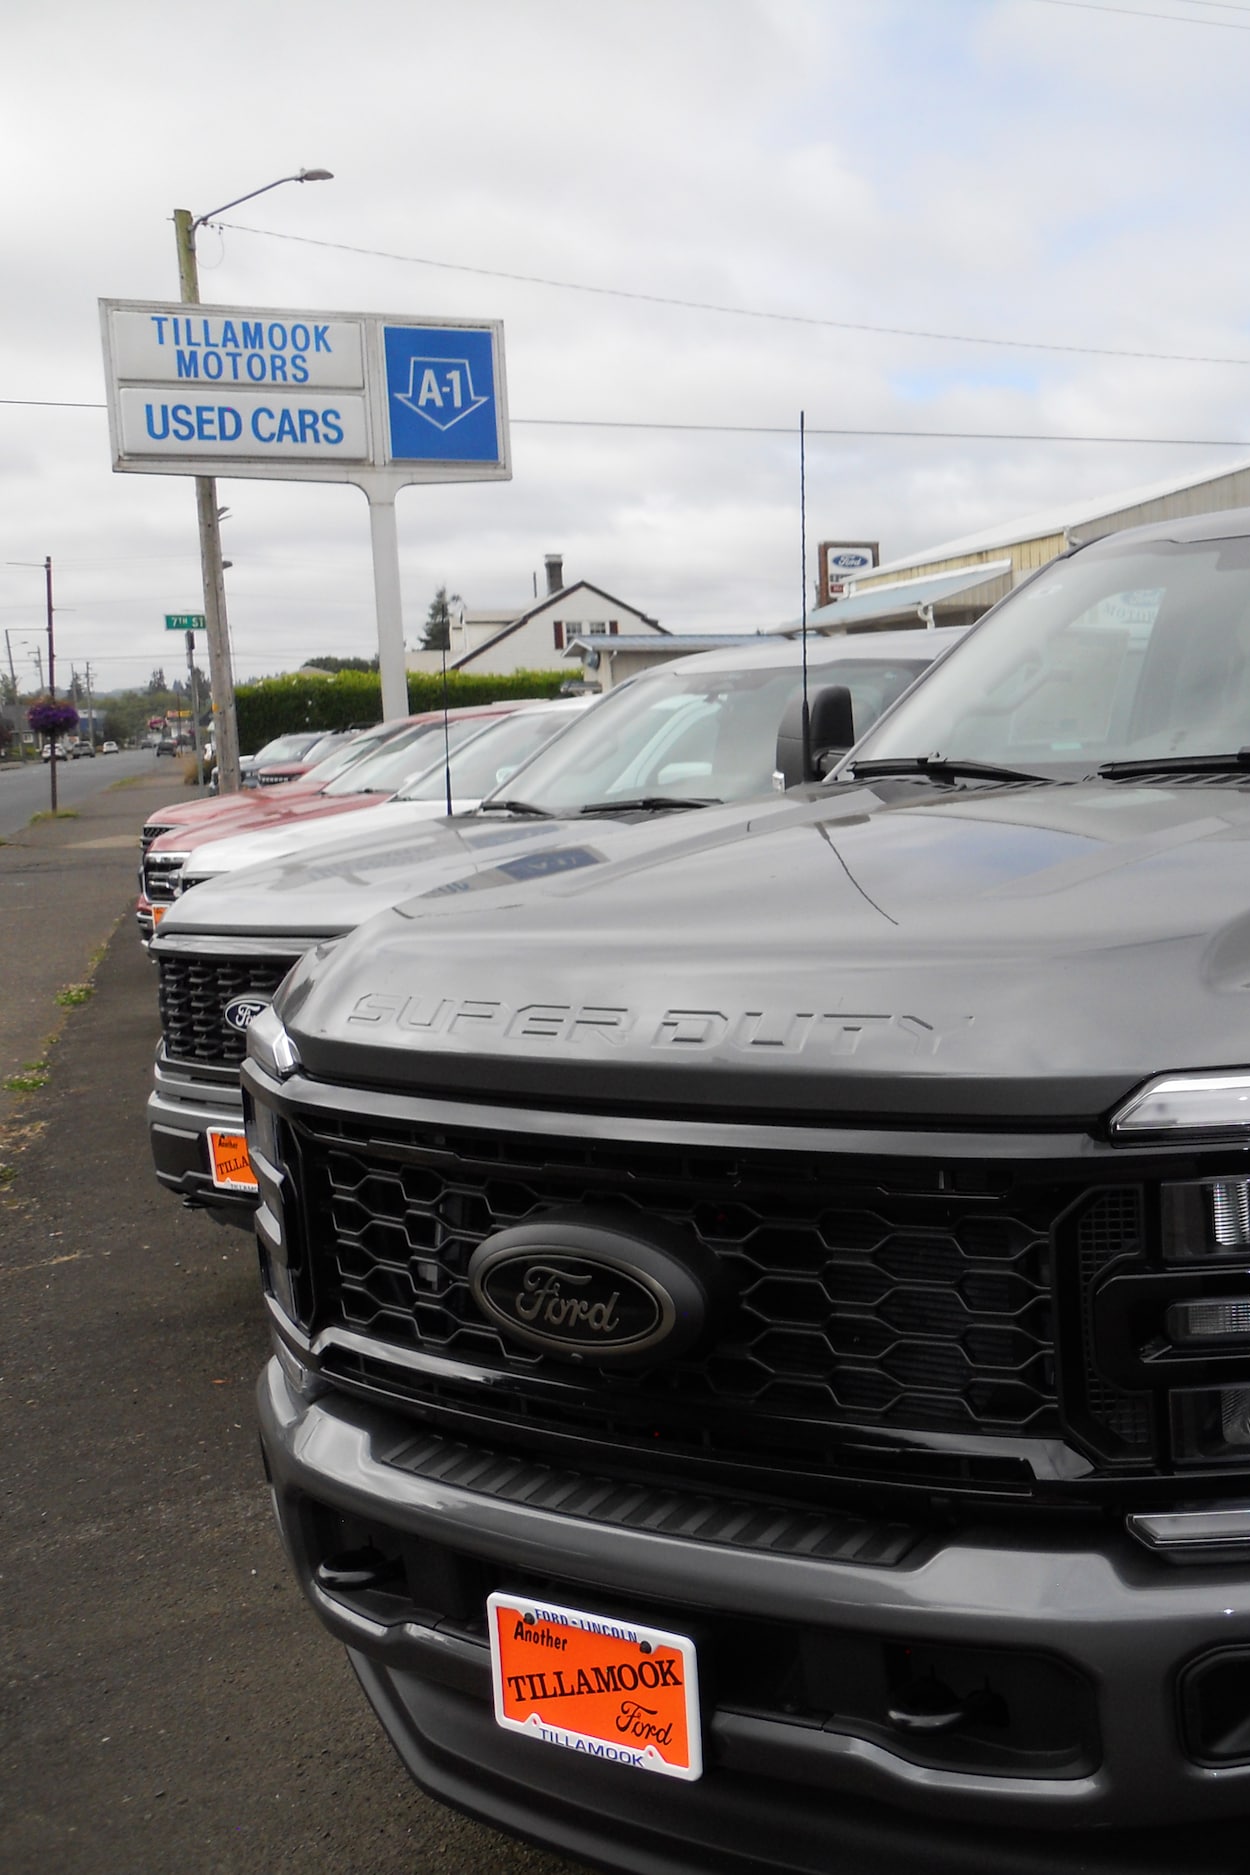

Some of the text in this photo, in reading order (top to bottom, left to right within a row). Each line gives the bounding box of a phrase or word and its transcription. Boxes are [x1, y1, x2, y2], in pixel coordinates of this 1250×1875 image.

[151, 315, 333, 353] TILLAMOOK
[176, 349, 310, 384] MOTORS
[417, 368, 464, 408] A-1
[145, 403, 344, 445] USED CARS
[171, 616, 204, 628] 7TH ST
[235, 1003, 261, 1027] Fo
[347, 992, 976, 1056] SUPER DUTY
[216, 1155, 249, 1175] TILLA
[515, 1265, 621, 1333] Ford
[513, 1620, 568, 1652] Another
[534, 1608, 638, 1643] FORD LINCOLN
[507, 1658, 683, 1702] TILLAMOOK
[615, 1700, 673, 1746] Ford
[538, 1727, 646, 1768] TILLAMOOK
